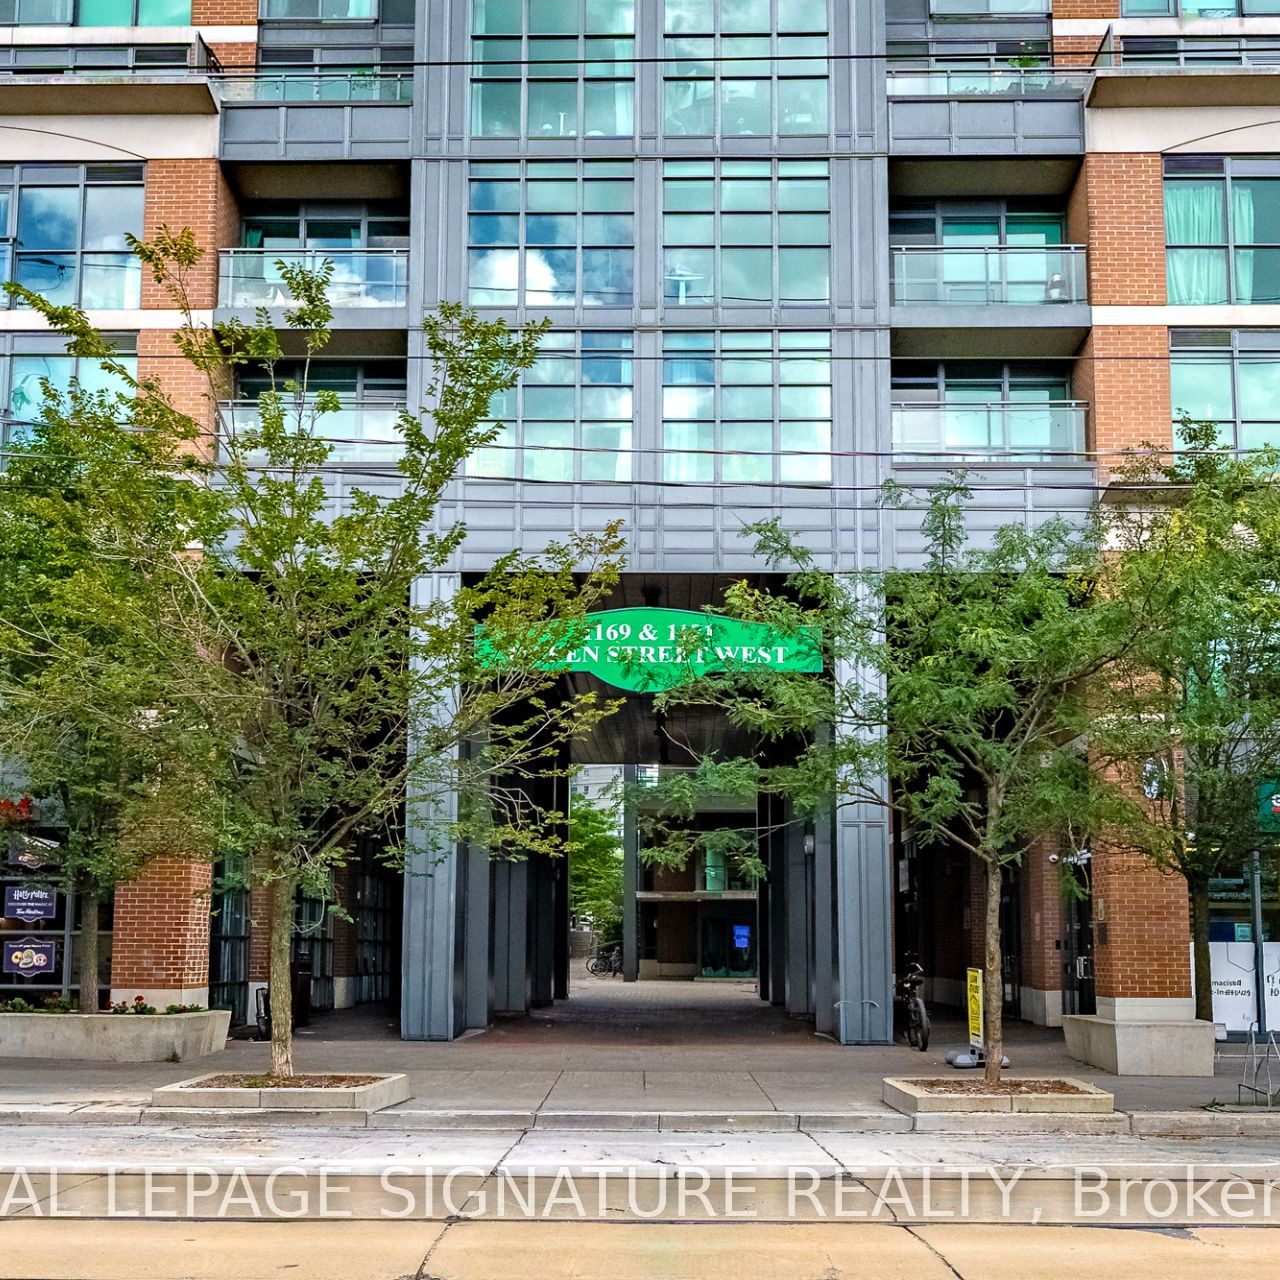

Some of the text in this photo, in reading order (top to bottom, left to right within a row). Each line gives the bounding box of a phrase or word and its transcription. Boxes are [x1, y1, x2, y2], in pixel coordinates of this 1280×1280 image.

[638, 623, 659, 641] &
[668, 624, 712, 641] 11
[715, 646, 789, 664] WEST
